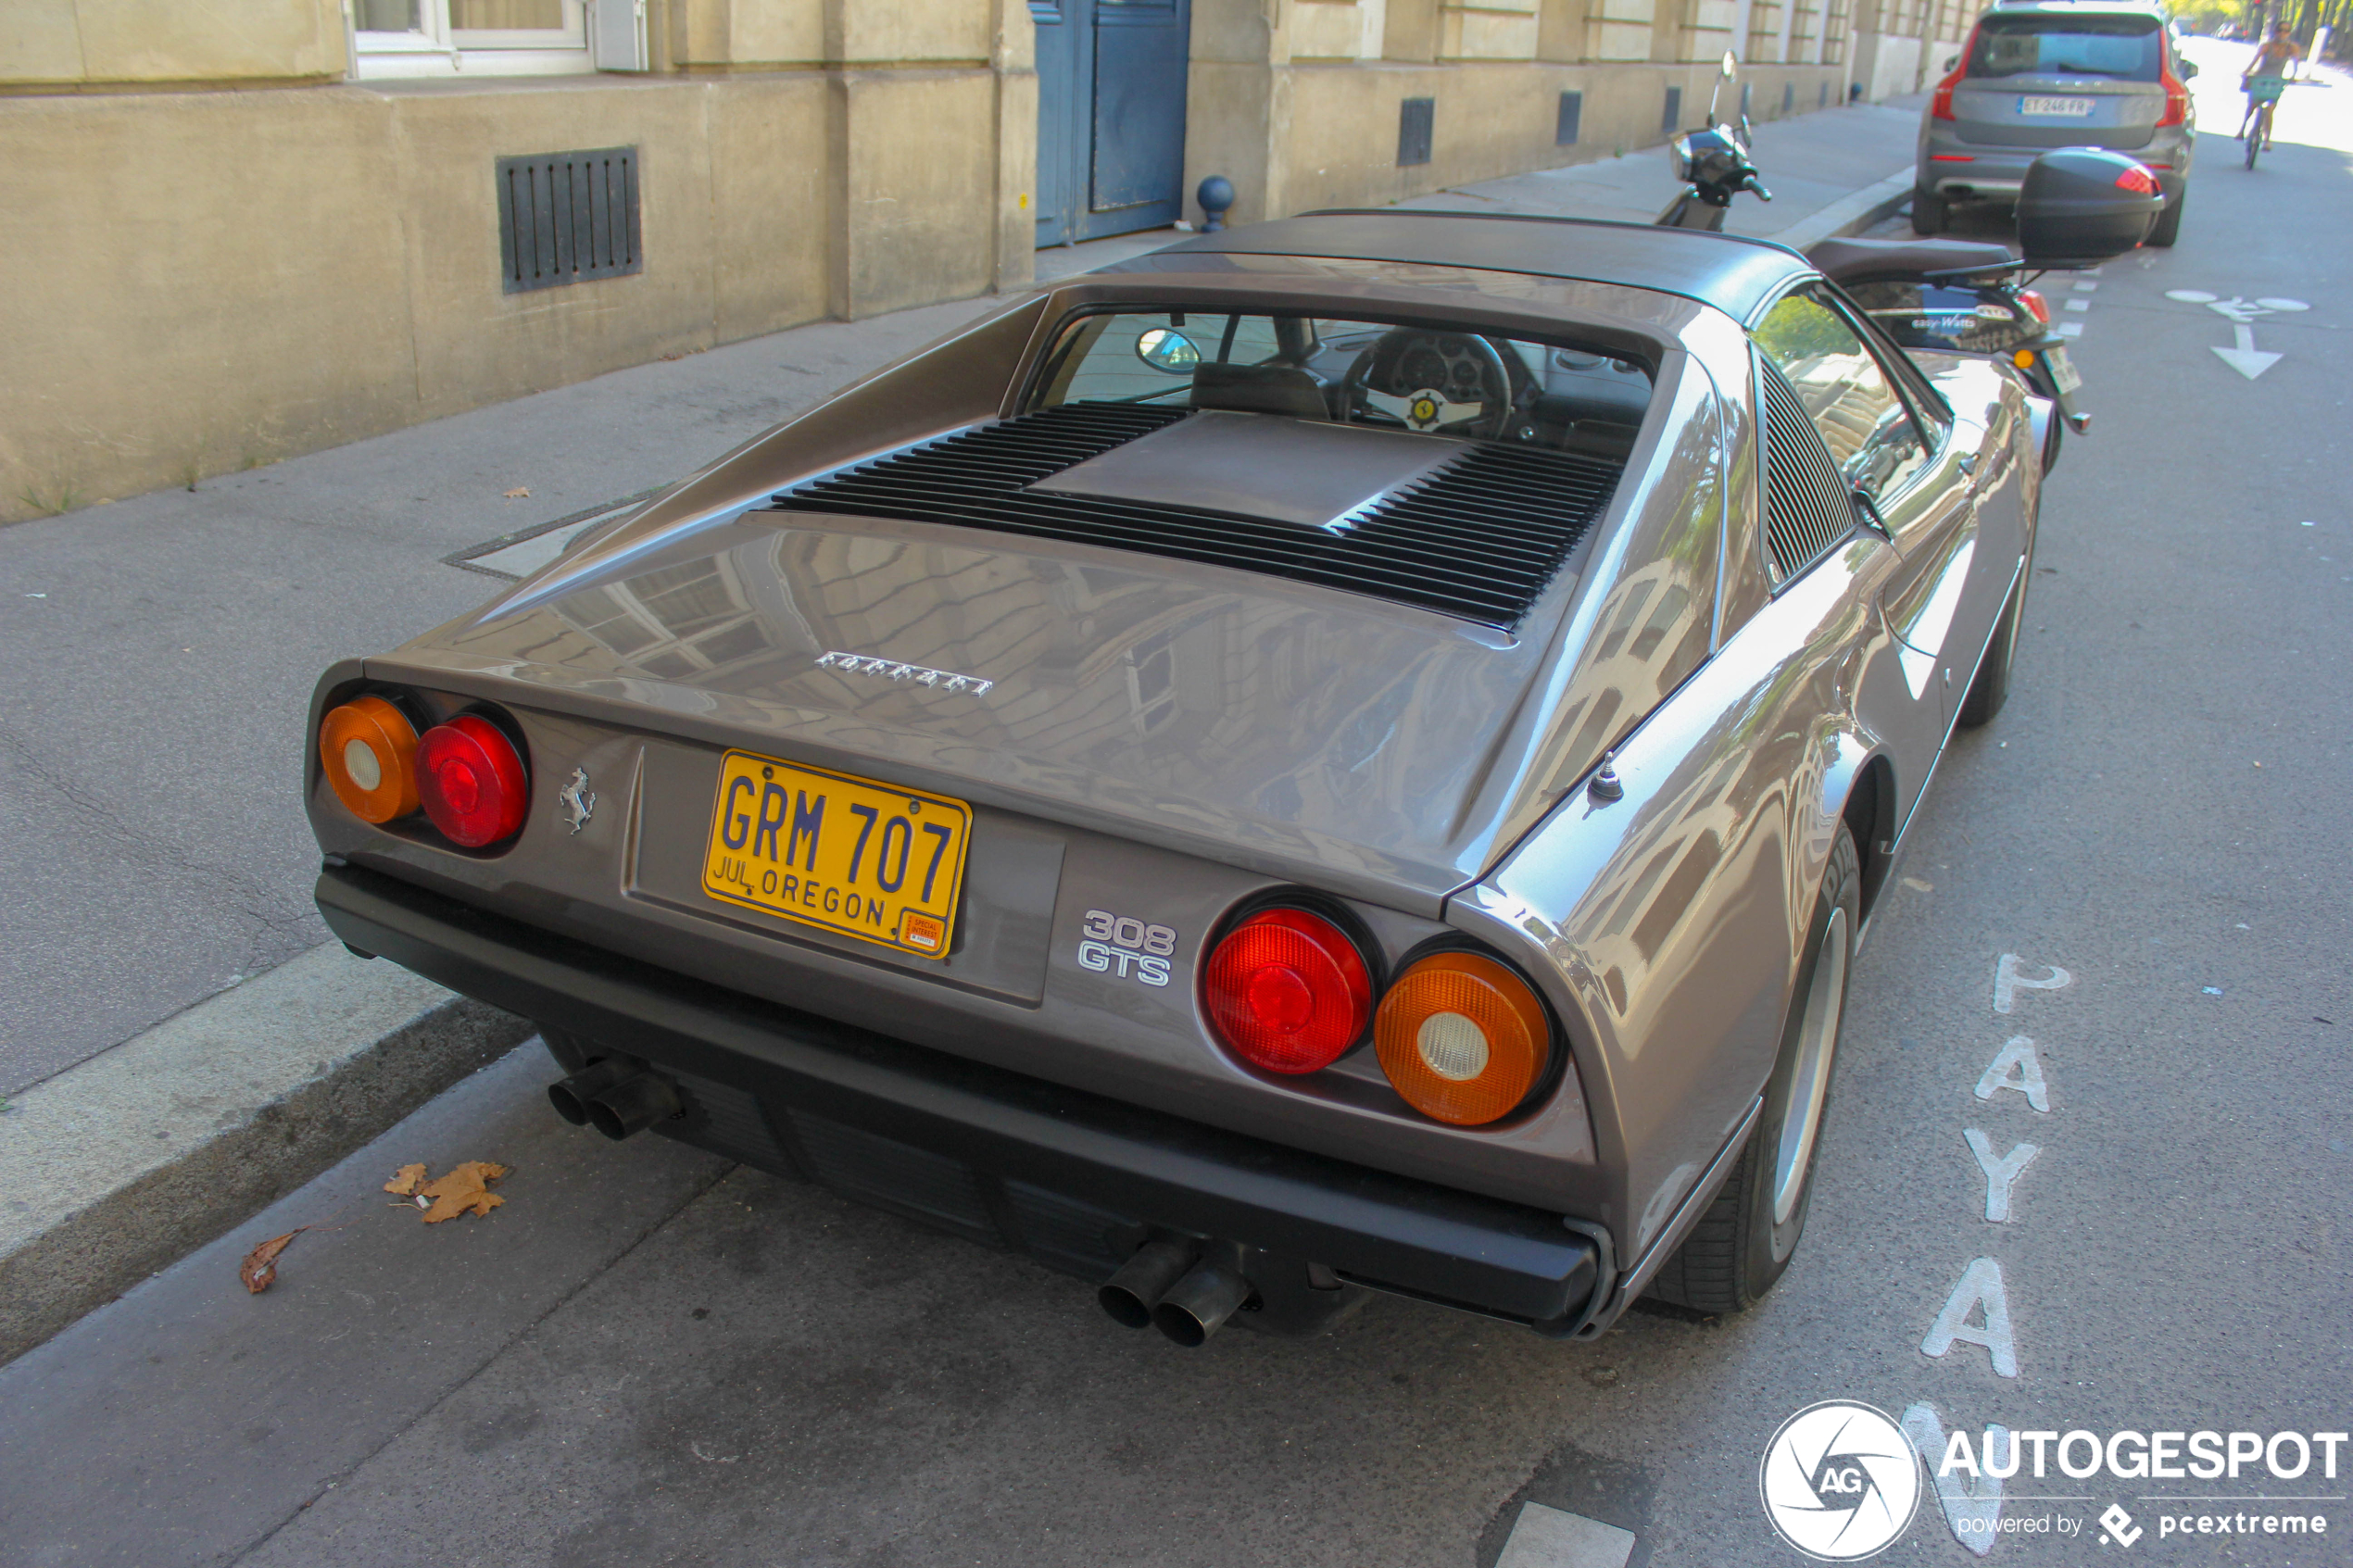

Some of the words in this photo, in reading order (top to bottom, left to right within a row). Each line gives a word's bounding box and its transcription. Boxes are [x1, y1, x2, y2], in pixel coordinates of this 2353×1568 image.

[722, 775, 827, 872] GRM
[849, 802, 953, 904] 707
[713, 856, 755, 889] JUL
[761, 869, 886, 927] OREGON
[912, 926, 937, 937] INTEREST
[914, 919, 937, 931] SPECIAL
[1083, 909, 1176, 956] 308
[1077, 939, 1171, 987] GTS
